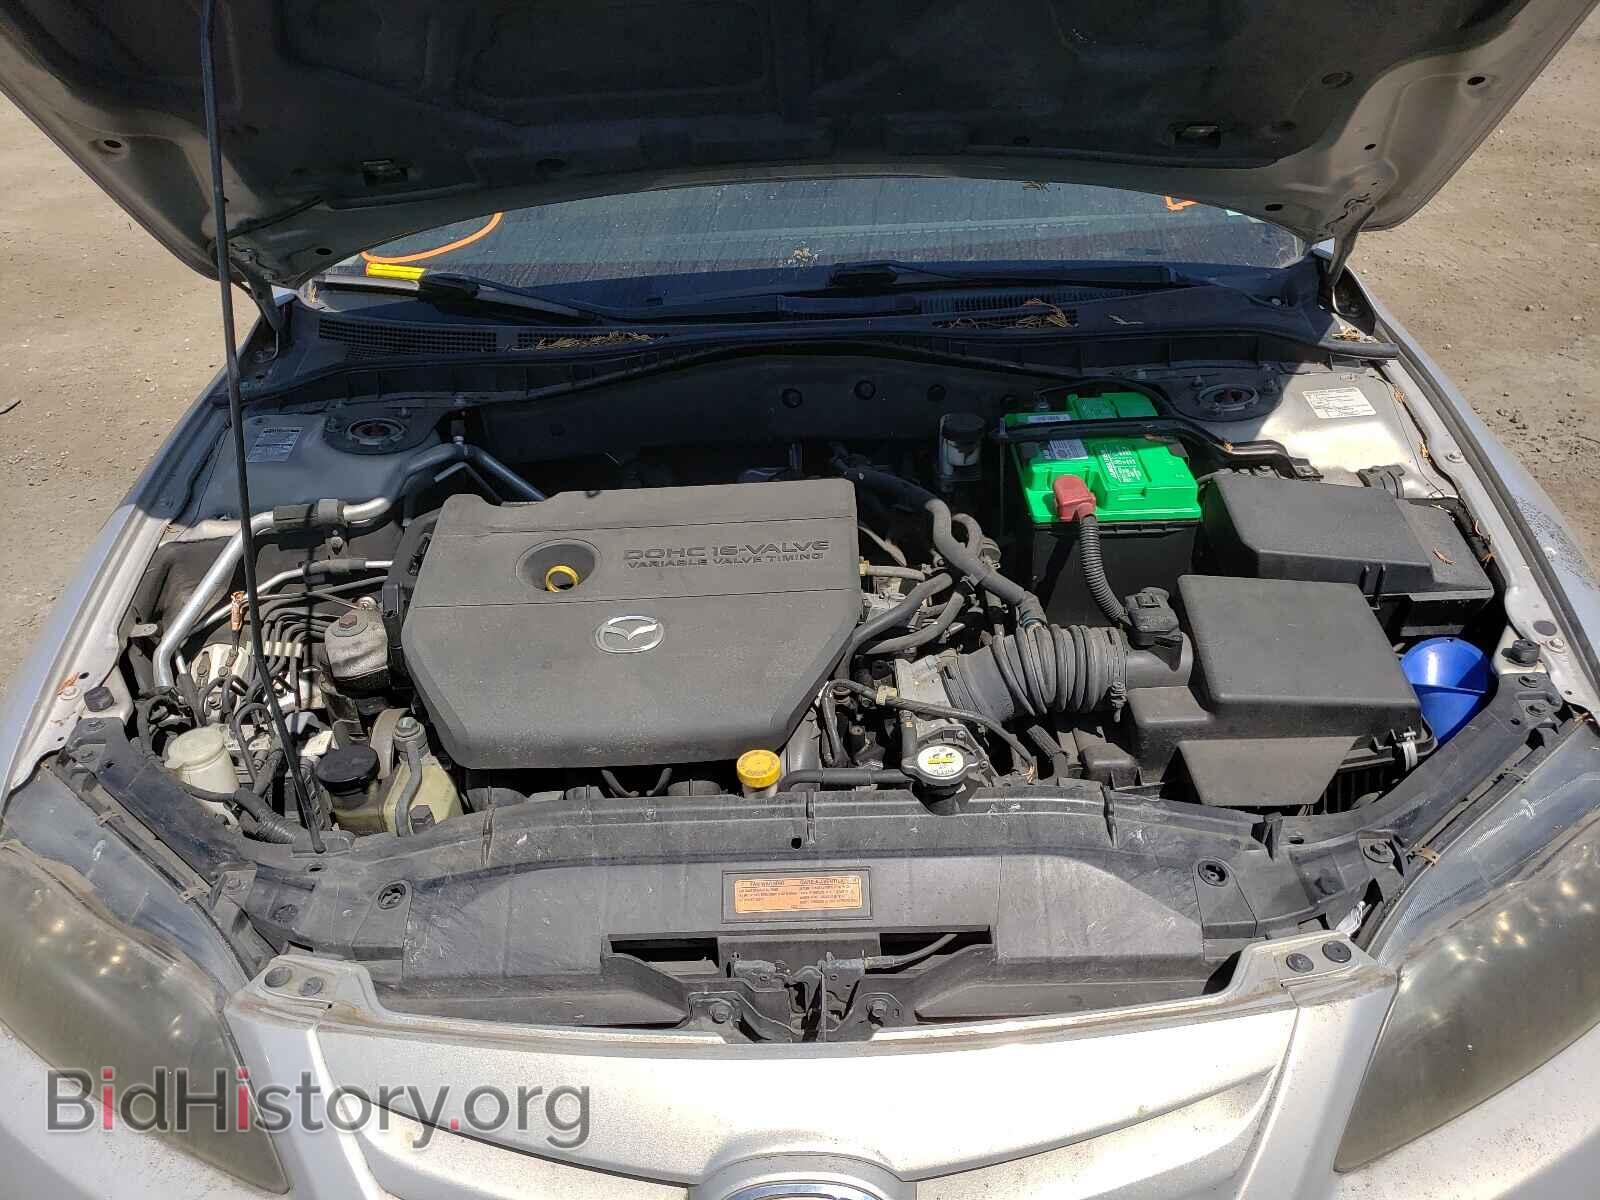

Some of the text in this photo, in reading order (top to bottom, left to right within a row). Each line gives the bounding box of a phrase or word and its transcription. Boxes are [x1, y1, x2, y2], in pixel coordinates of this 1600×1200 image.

[624, 540, 831, 560] DOHC 16-VALVE
[626, 553, 823, 568] VARIABLE VALVE TIMING
